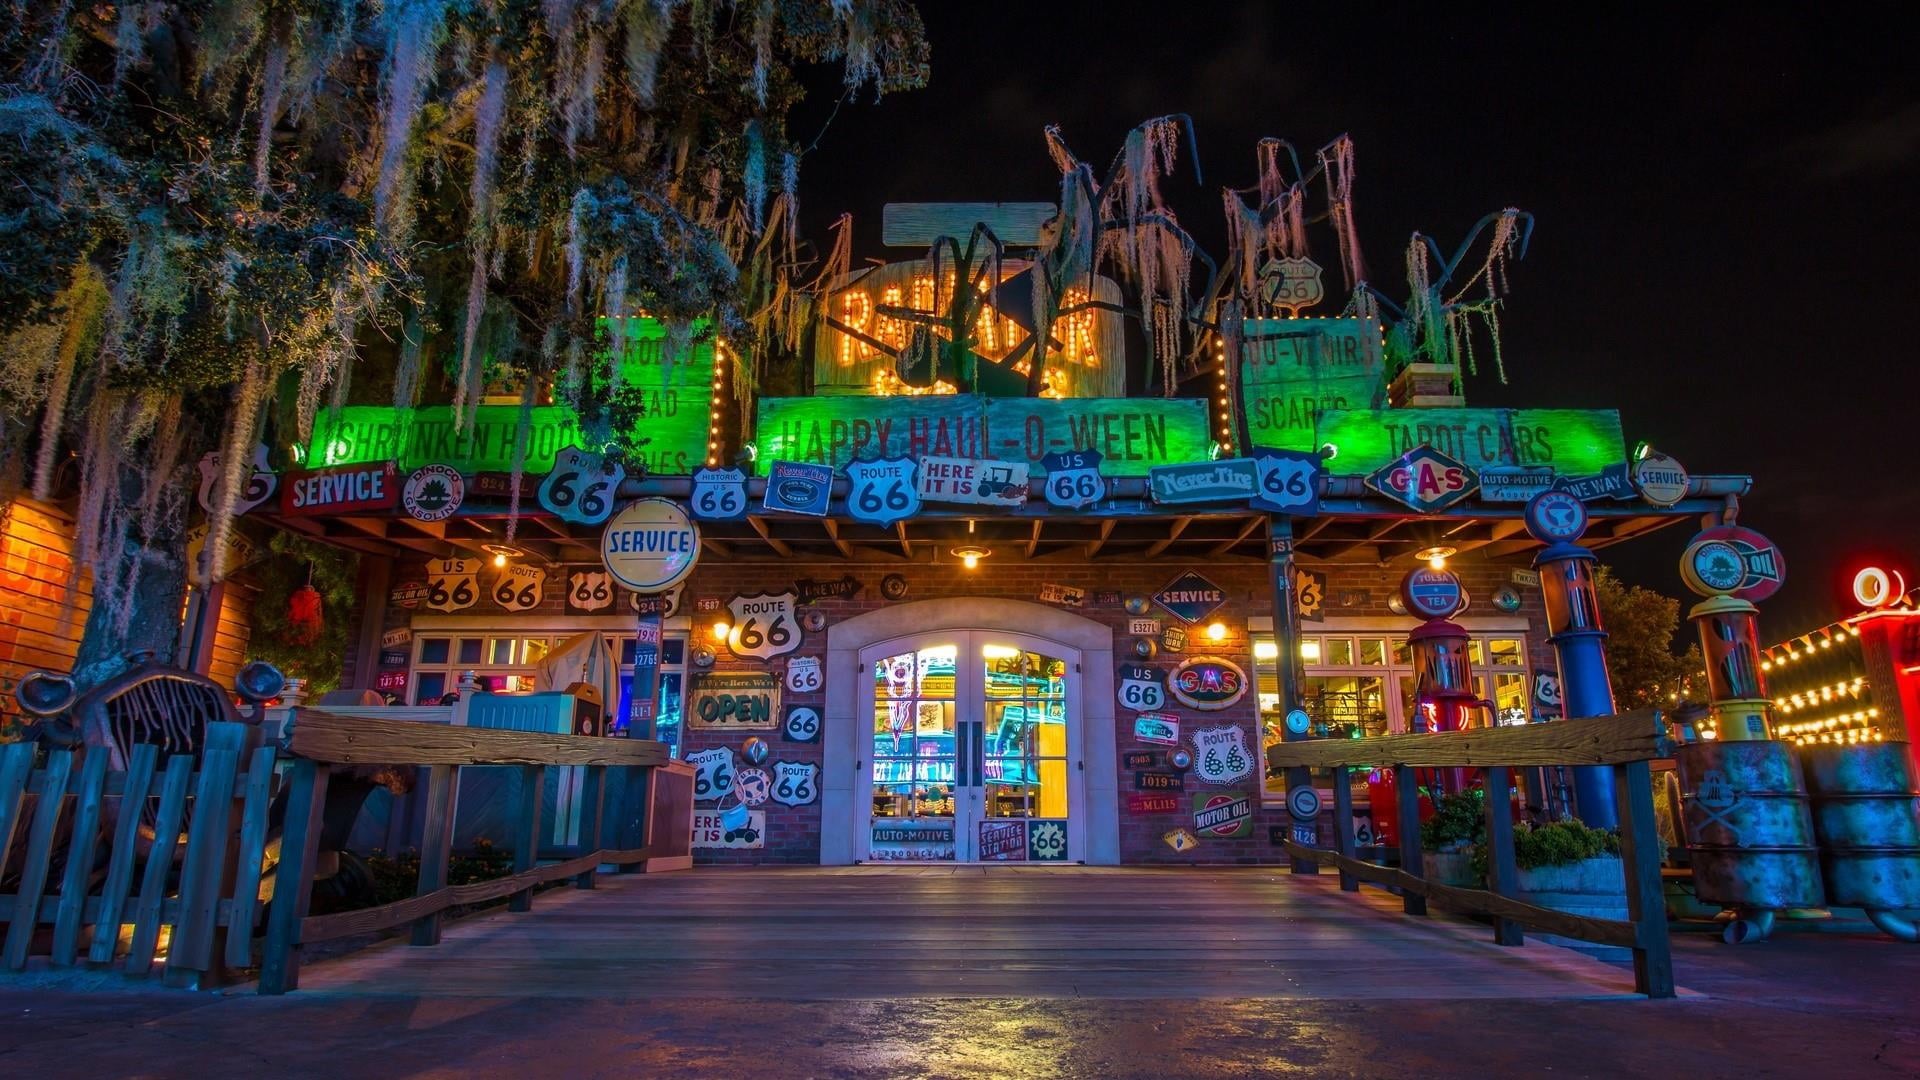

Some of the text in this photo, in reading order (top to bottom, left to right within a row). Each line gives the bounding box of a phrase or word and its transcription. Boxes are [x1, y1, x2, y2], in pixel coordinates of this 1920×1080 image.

[782, 418, 892, 464] HAPPY
[1477, 424, 1553, 464] CARS
[927, 463, 975, 480] HERE
[1060, 455, 1085, 468] US
[412, 464, 460, 482] DINOCO
[702, 473, 738, 481] HISTORIC
[860, 467, 902, 479] ROUTE
[1157, 467, 1253, 496] Never Tire
[1263, 468, 1308, 497] 66
[1483, 475, 1551, 485] AUTO-MOTIVE
[1592, 473, 1622, 494] WAY
[1641, 471, 1686, 485] SERVICE
[293, 470, 384, 508] SERVICE
[548, 471, 609, 517] 66
[858, 481, 909, 513] 66
[925, 478, 973, 495] IT IS
[1054, 474, 1096, 500] 66
[404, 495, 461, 522] GASOLINE
[699, 491, 737, 513] 66
[609, 530, 690, 553] SERVICE
[443, 561, 465, 574] US
[508, 566, 540, 579] ROUTE
[1750, 553, 1776, 576] OIL
[1418, 572, 1449, 582] TULSA
[429, 578, 474, 606] 66
[496, 578, 536, 608] 66
[576, 581, 607, 602] 66
[1162, 589, 1221, 603] SERVICE
[1426, 597, 1448, 607] TEA
[742, 600, 786, 615] ROUTE
[739, 615, 791, 649] 66
[792, 672, 819, 689] 66
[1133, 668, 1152, 680] US
[1180, 670, 1238, 693] GAS
[1125, 684, 1158, 706] 66
[697, 693, 771, 723] OPEN
[788, 714, 817, 734] 66
[1203, 731, 1238, 746] ROUTE
[693, 752, 725, 765] ROUTE
[1204, 744, 1247, 776] 66
[694, 763, 732, 795] 66
[782, 767, 810, 777] ROUTE
[1141, 776, 1168, 787] 1019
[776, 777, 810, 799] 66
[694, 816, 722, 829] ERE
[1196, 806, 1231, 829] MOTOR
[1232, 801, 1249, 817] OIL
[703, 829, 721, 842] IS
[874, 829, 951, 842] AUTO-MOTIVE
[980, 824, 1023, 846] SERVICE
[1036, 830, 1061, 850] 66
[980, 835, 1023, 857] STATION
